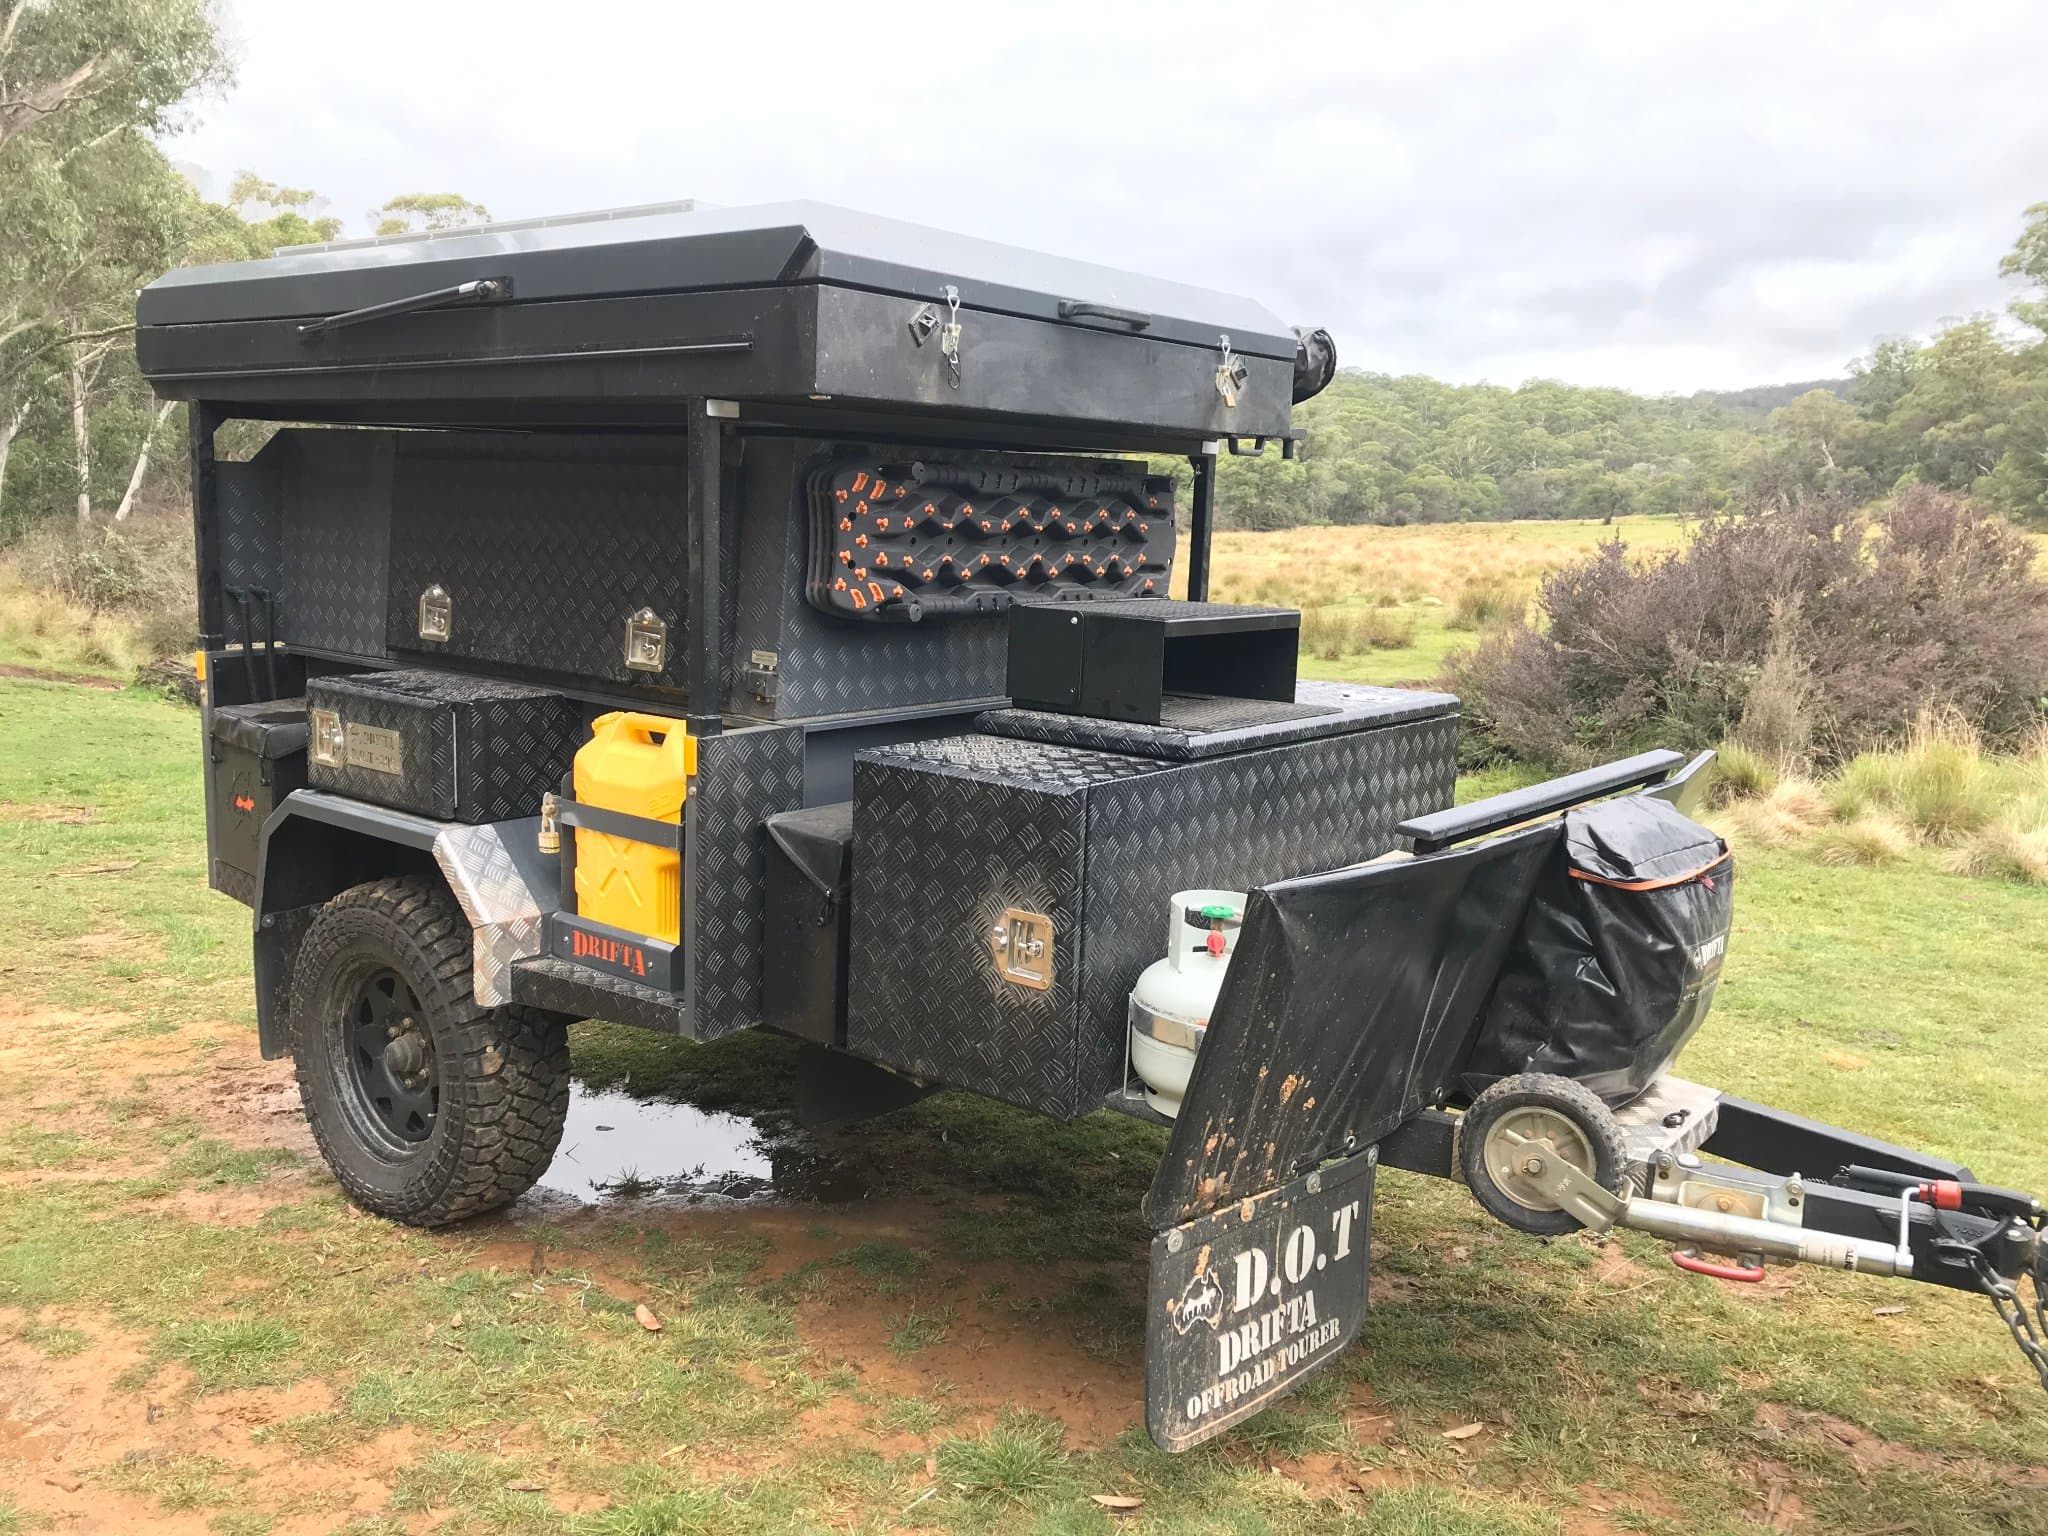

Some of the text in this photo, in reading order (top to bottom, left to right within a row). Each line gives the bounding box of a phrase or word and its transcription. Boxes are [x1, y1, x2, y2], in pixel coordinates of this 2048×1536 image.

[572, 929, 646, 977] DRIFTA
[1233, 1200, 1360, 1313] D.O.T
[1186, 1317, 1341, 1420] OFFROAD TOURER
[1218, 1289, 1318, 1377] DRIFTA
